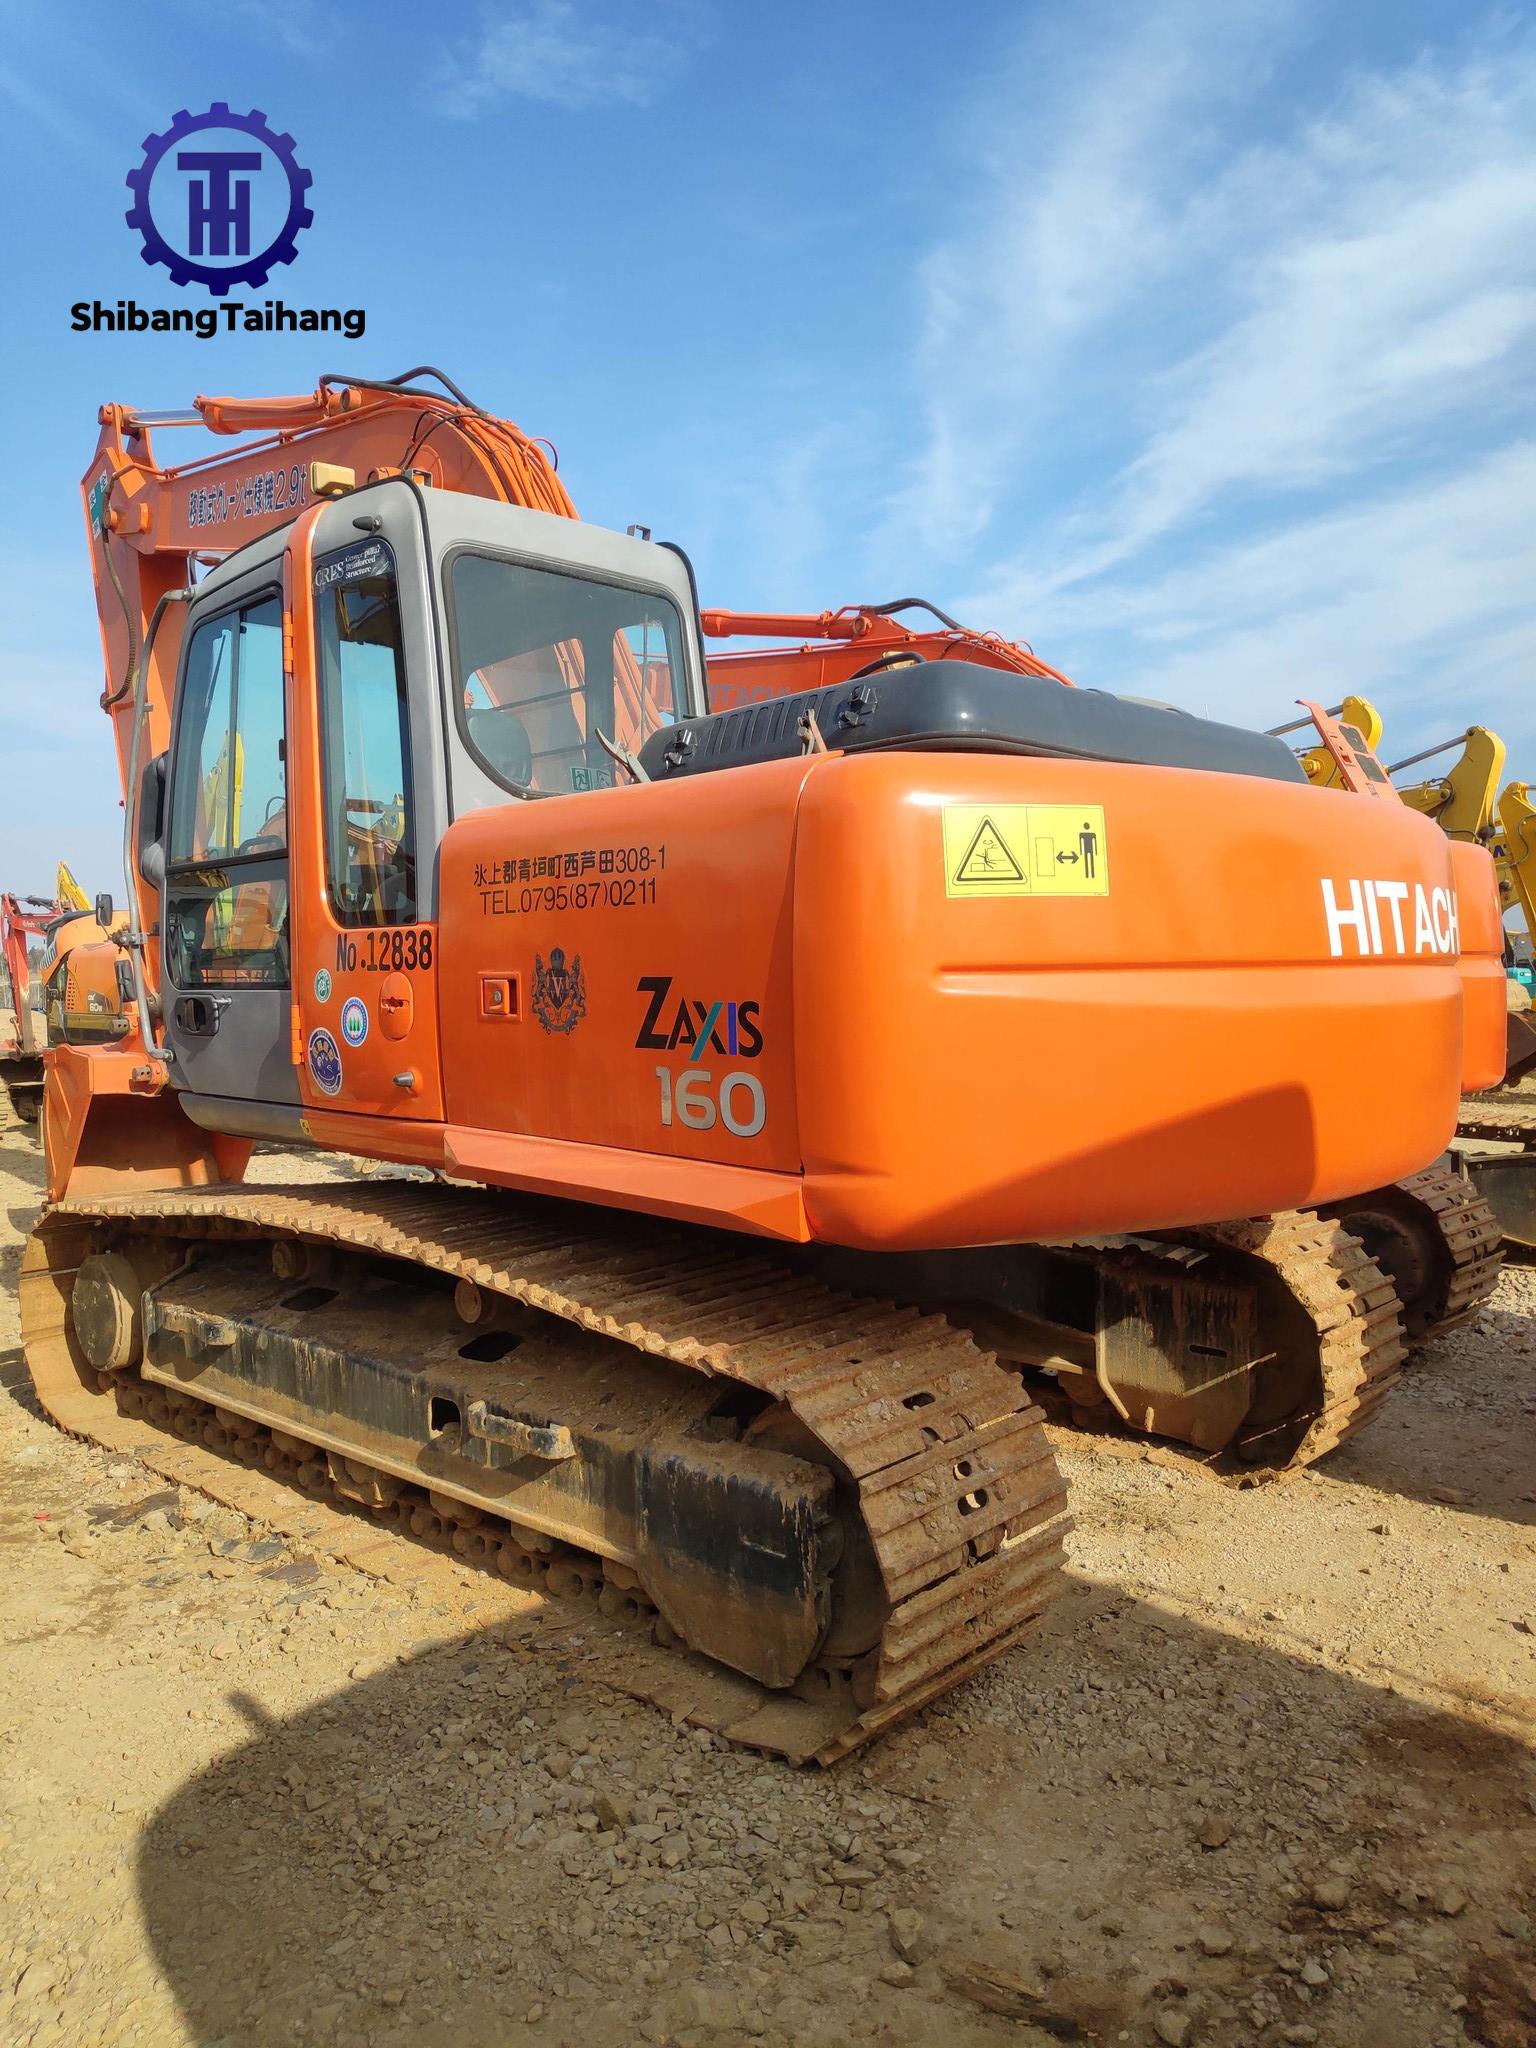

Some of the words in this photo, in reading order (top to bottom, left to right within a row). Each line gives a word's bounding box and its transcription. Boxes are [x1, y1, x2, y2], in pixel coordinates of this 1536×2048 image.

[473, 845, 665, 887] 氷上郡青垣町西芦田308-1
[480, 877, 656, 915] TEL.0795(87)0211
[635, 976, 764, 1063] ZAXIS
[656, 1066, 767, 1137] 160
